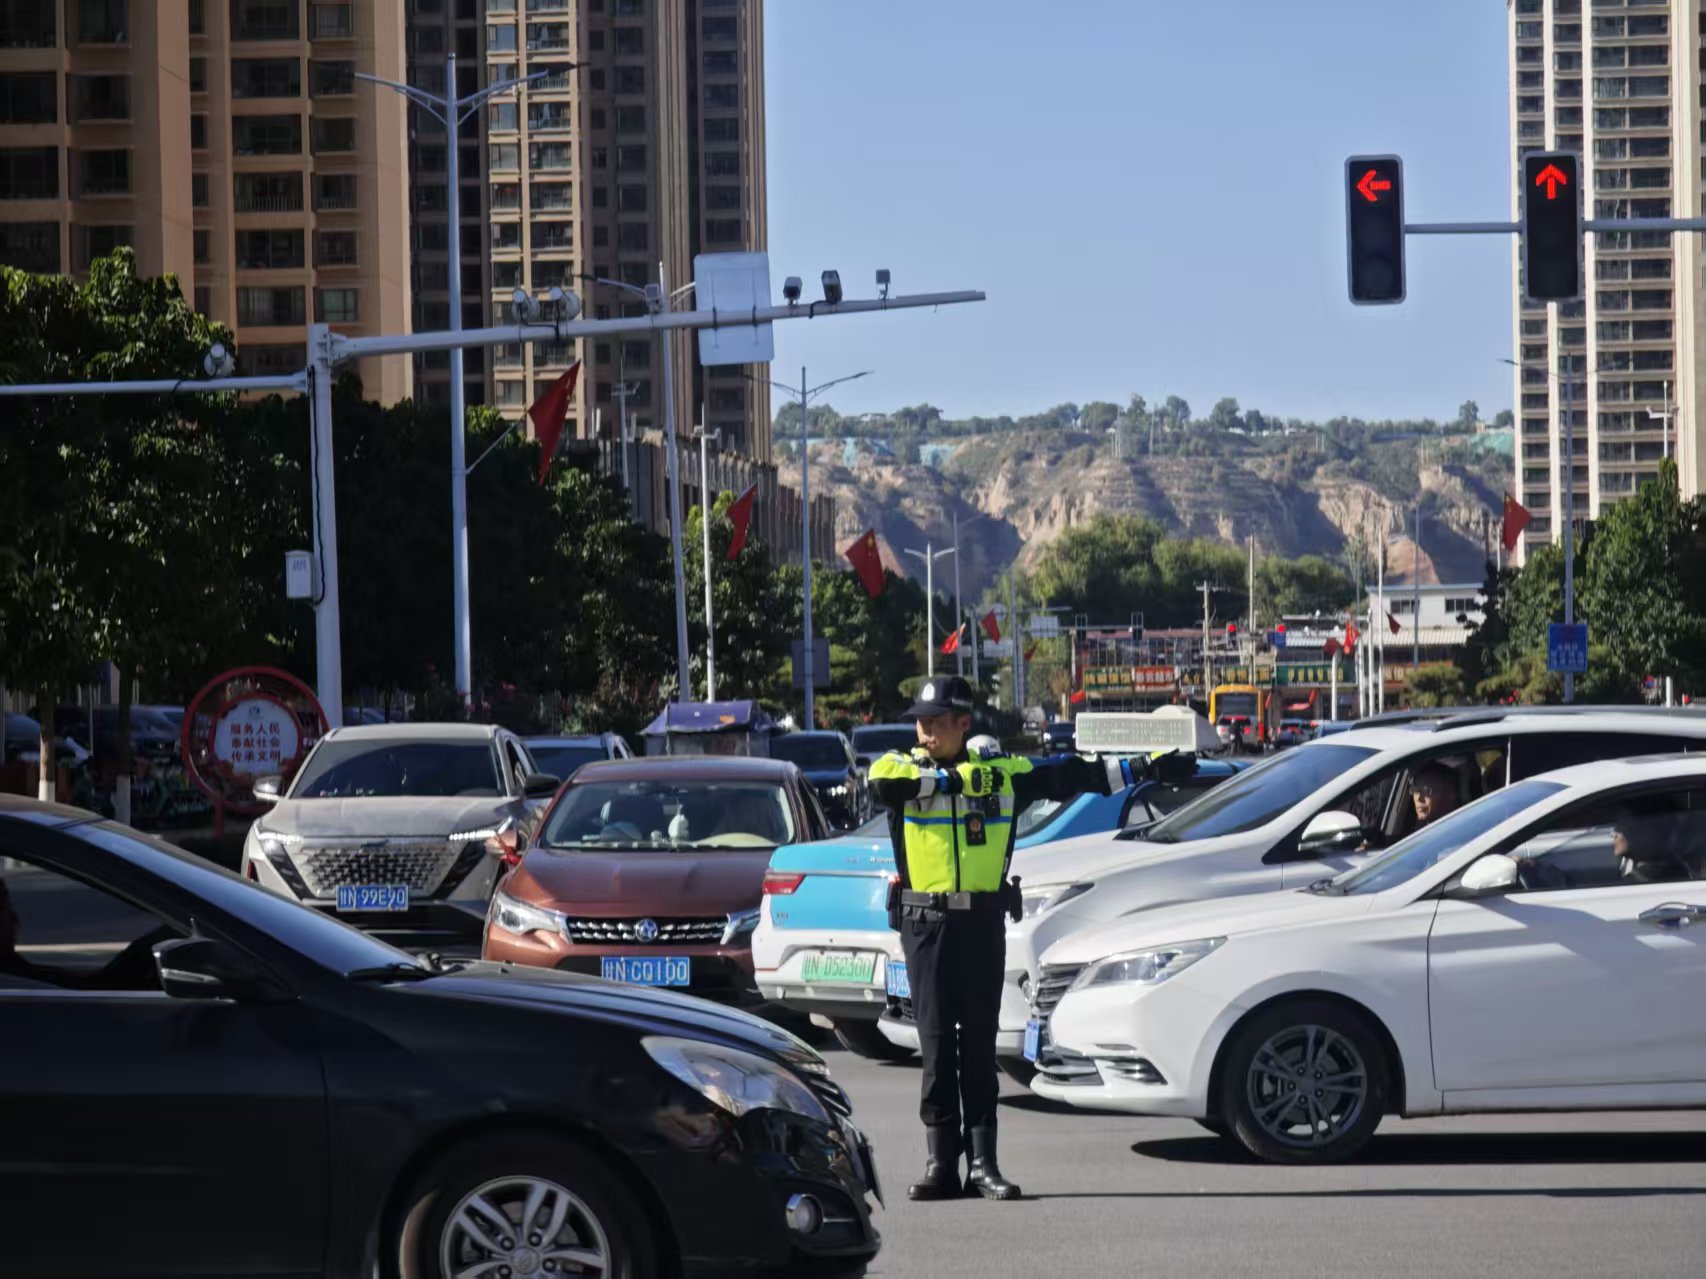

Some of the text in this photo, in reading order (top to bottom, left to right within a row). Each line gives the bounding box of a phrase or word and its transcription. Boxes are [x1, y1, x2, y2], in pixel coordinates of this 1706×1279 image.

[231, 722, 281, 735] 服务人民
[231, 736, 281, 749] 奉献社会
[231, 750, 281, 762] 传承文明
